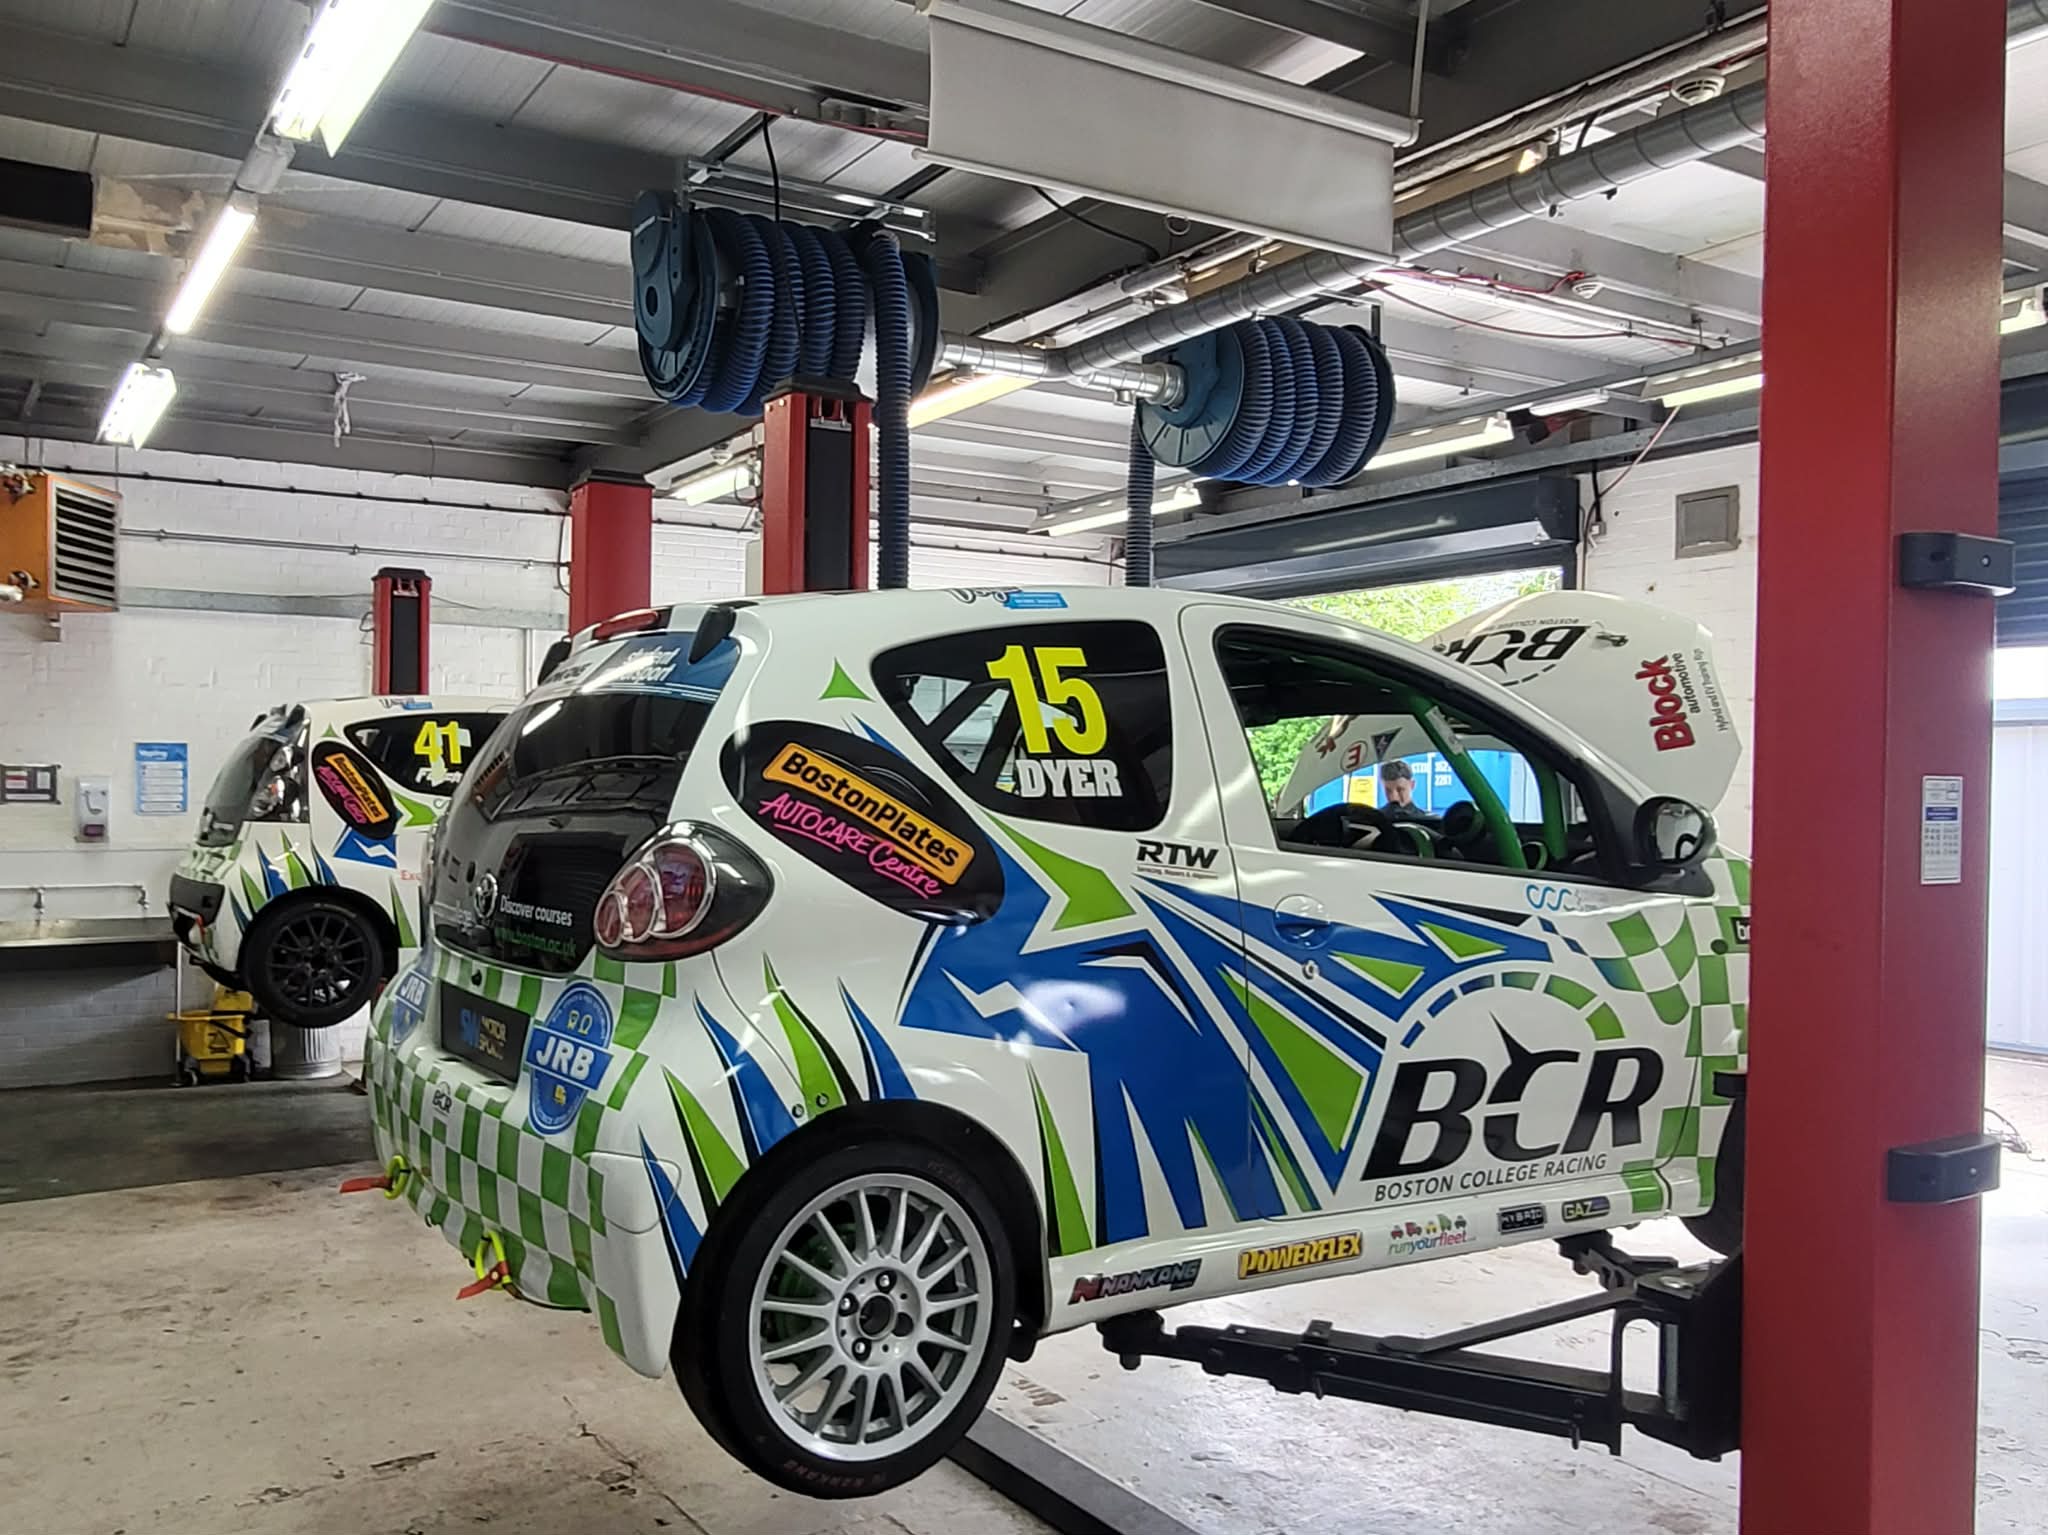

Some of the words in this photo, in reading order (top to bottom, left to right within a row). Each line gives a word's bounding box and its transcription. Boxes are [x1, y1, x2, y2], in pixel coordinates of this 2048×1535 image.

[986, 645, 1107, 755] 15
[1635, 654, 1696, 752] Block
[1672, 652, 1701, 714] automotive
[414, 721, 462, 764] 41
[1015, 759, 1123, 797] DYER
[781, 751, 960, 867] BostonPlates
[758, 793, 874, 855] AUTOCARE
[868, 840, 942, 895] Centre
[1136, 838, 1219, 869] RTW
[500, 895, 533, 918] Discover
[535, 906, 573, 926] courses
[400, 975, 427, 1006] JRB
[536, 1036, 595, 1081] JRB
[1360, 1020, 1664, 1181] BCR
[1375, 1173, 1453, 1201] BOSTON
[1460, 1163, 1538, 1189] COLLEGE
[1547, 1154, 1607, 1179] RACING
[1564, 1200, 1594, 1219] GAZ
[1239, 1233, 1362, 1278] POWERFLEX
[1100, 1259, 1201, 1298] NANKANG
